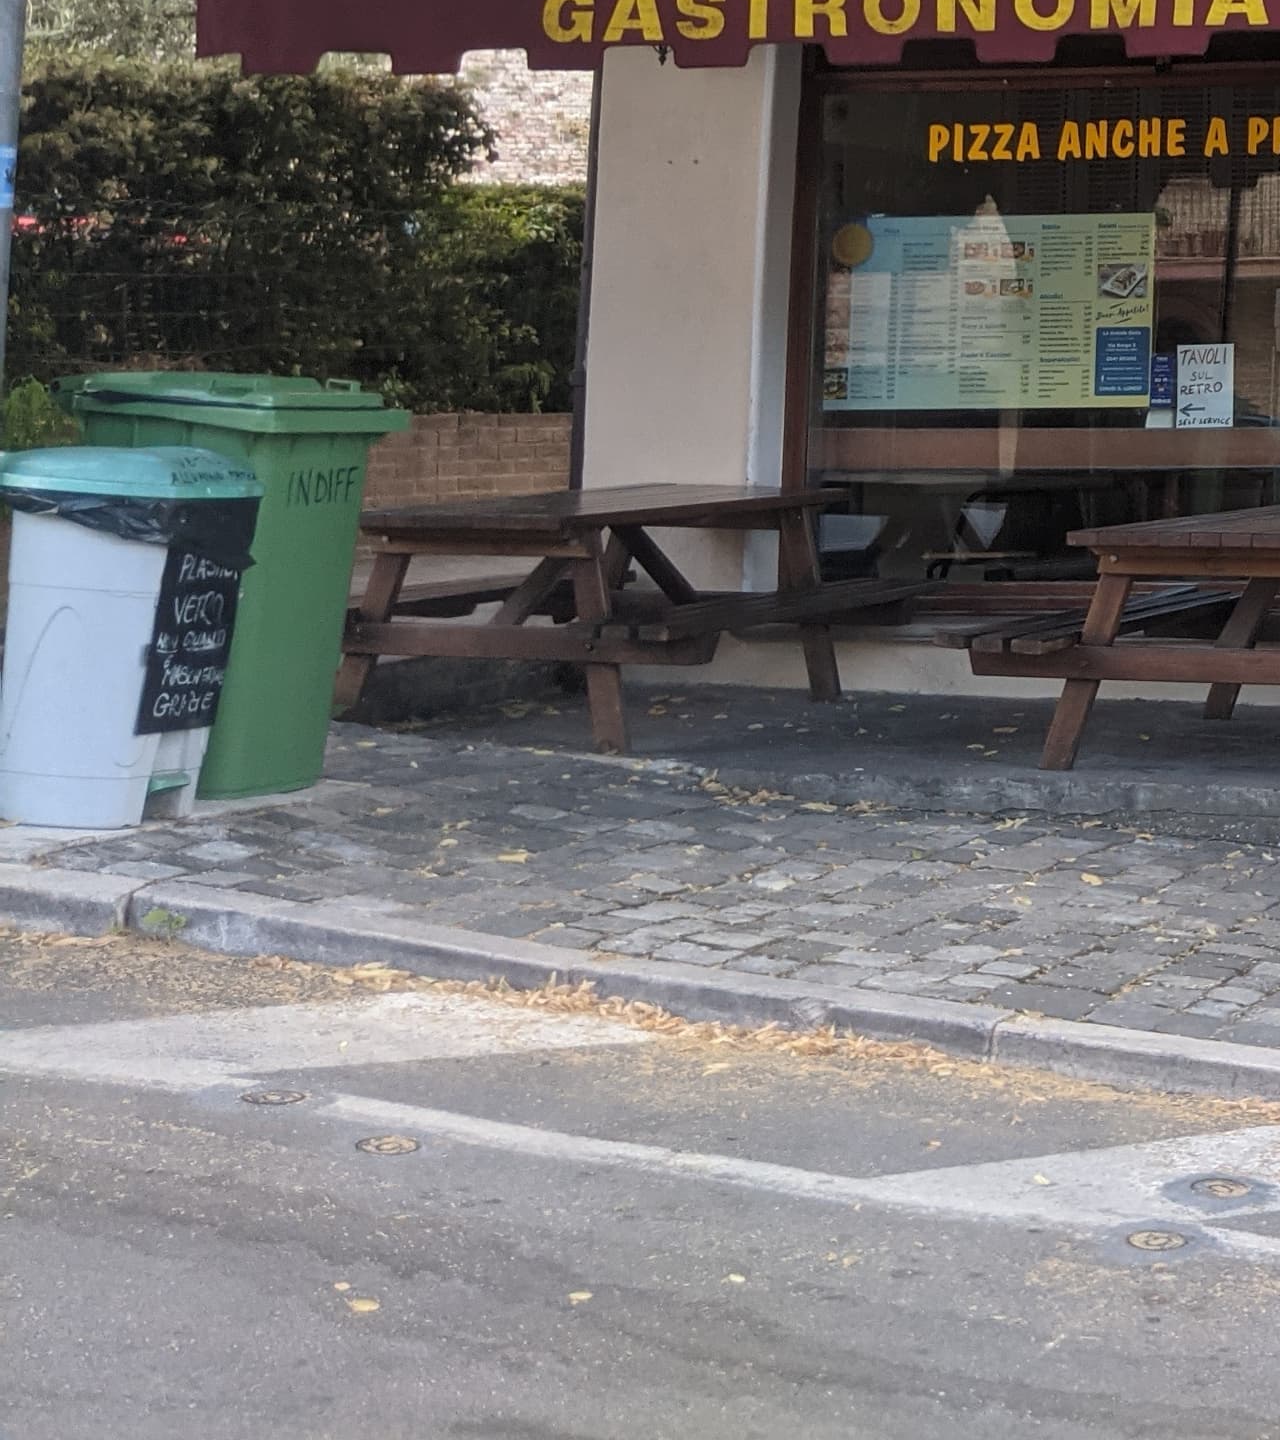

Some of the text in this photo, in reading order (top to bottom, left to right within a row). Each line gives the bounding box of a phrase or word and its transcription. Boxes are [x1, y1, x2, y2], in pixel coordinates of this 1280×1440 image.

[928, 122, 1040, 162] PIZZA
[1057, 118, 1186, 159] ANCHE
[1204, 117, 1228, 157] A
[1181, 347, 1227, 366] TAVOLI
[1190, 371, 1213, 382] SUL
[1181, 382, 1223, 395] RETRO
[1199, 417, 1231, 426] SERVICE
[288, 466, 359, 507] INDIFF
